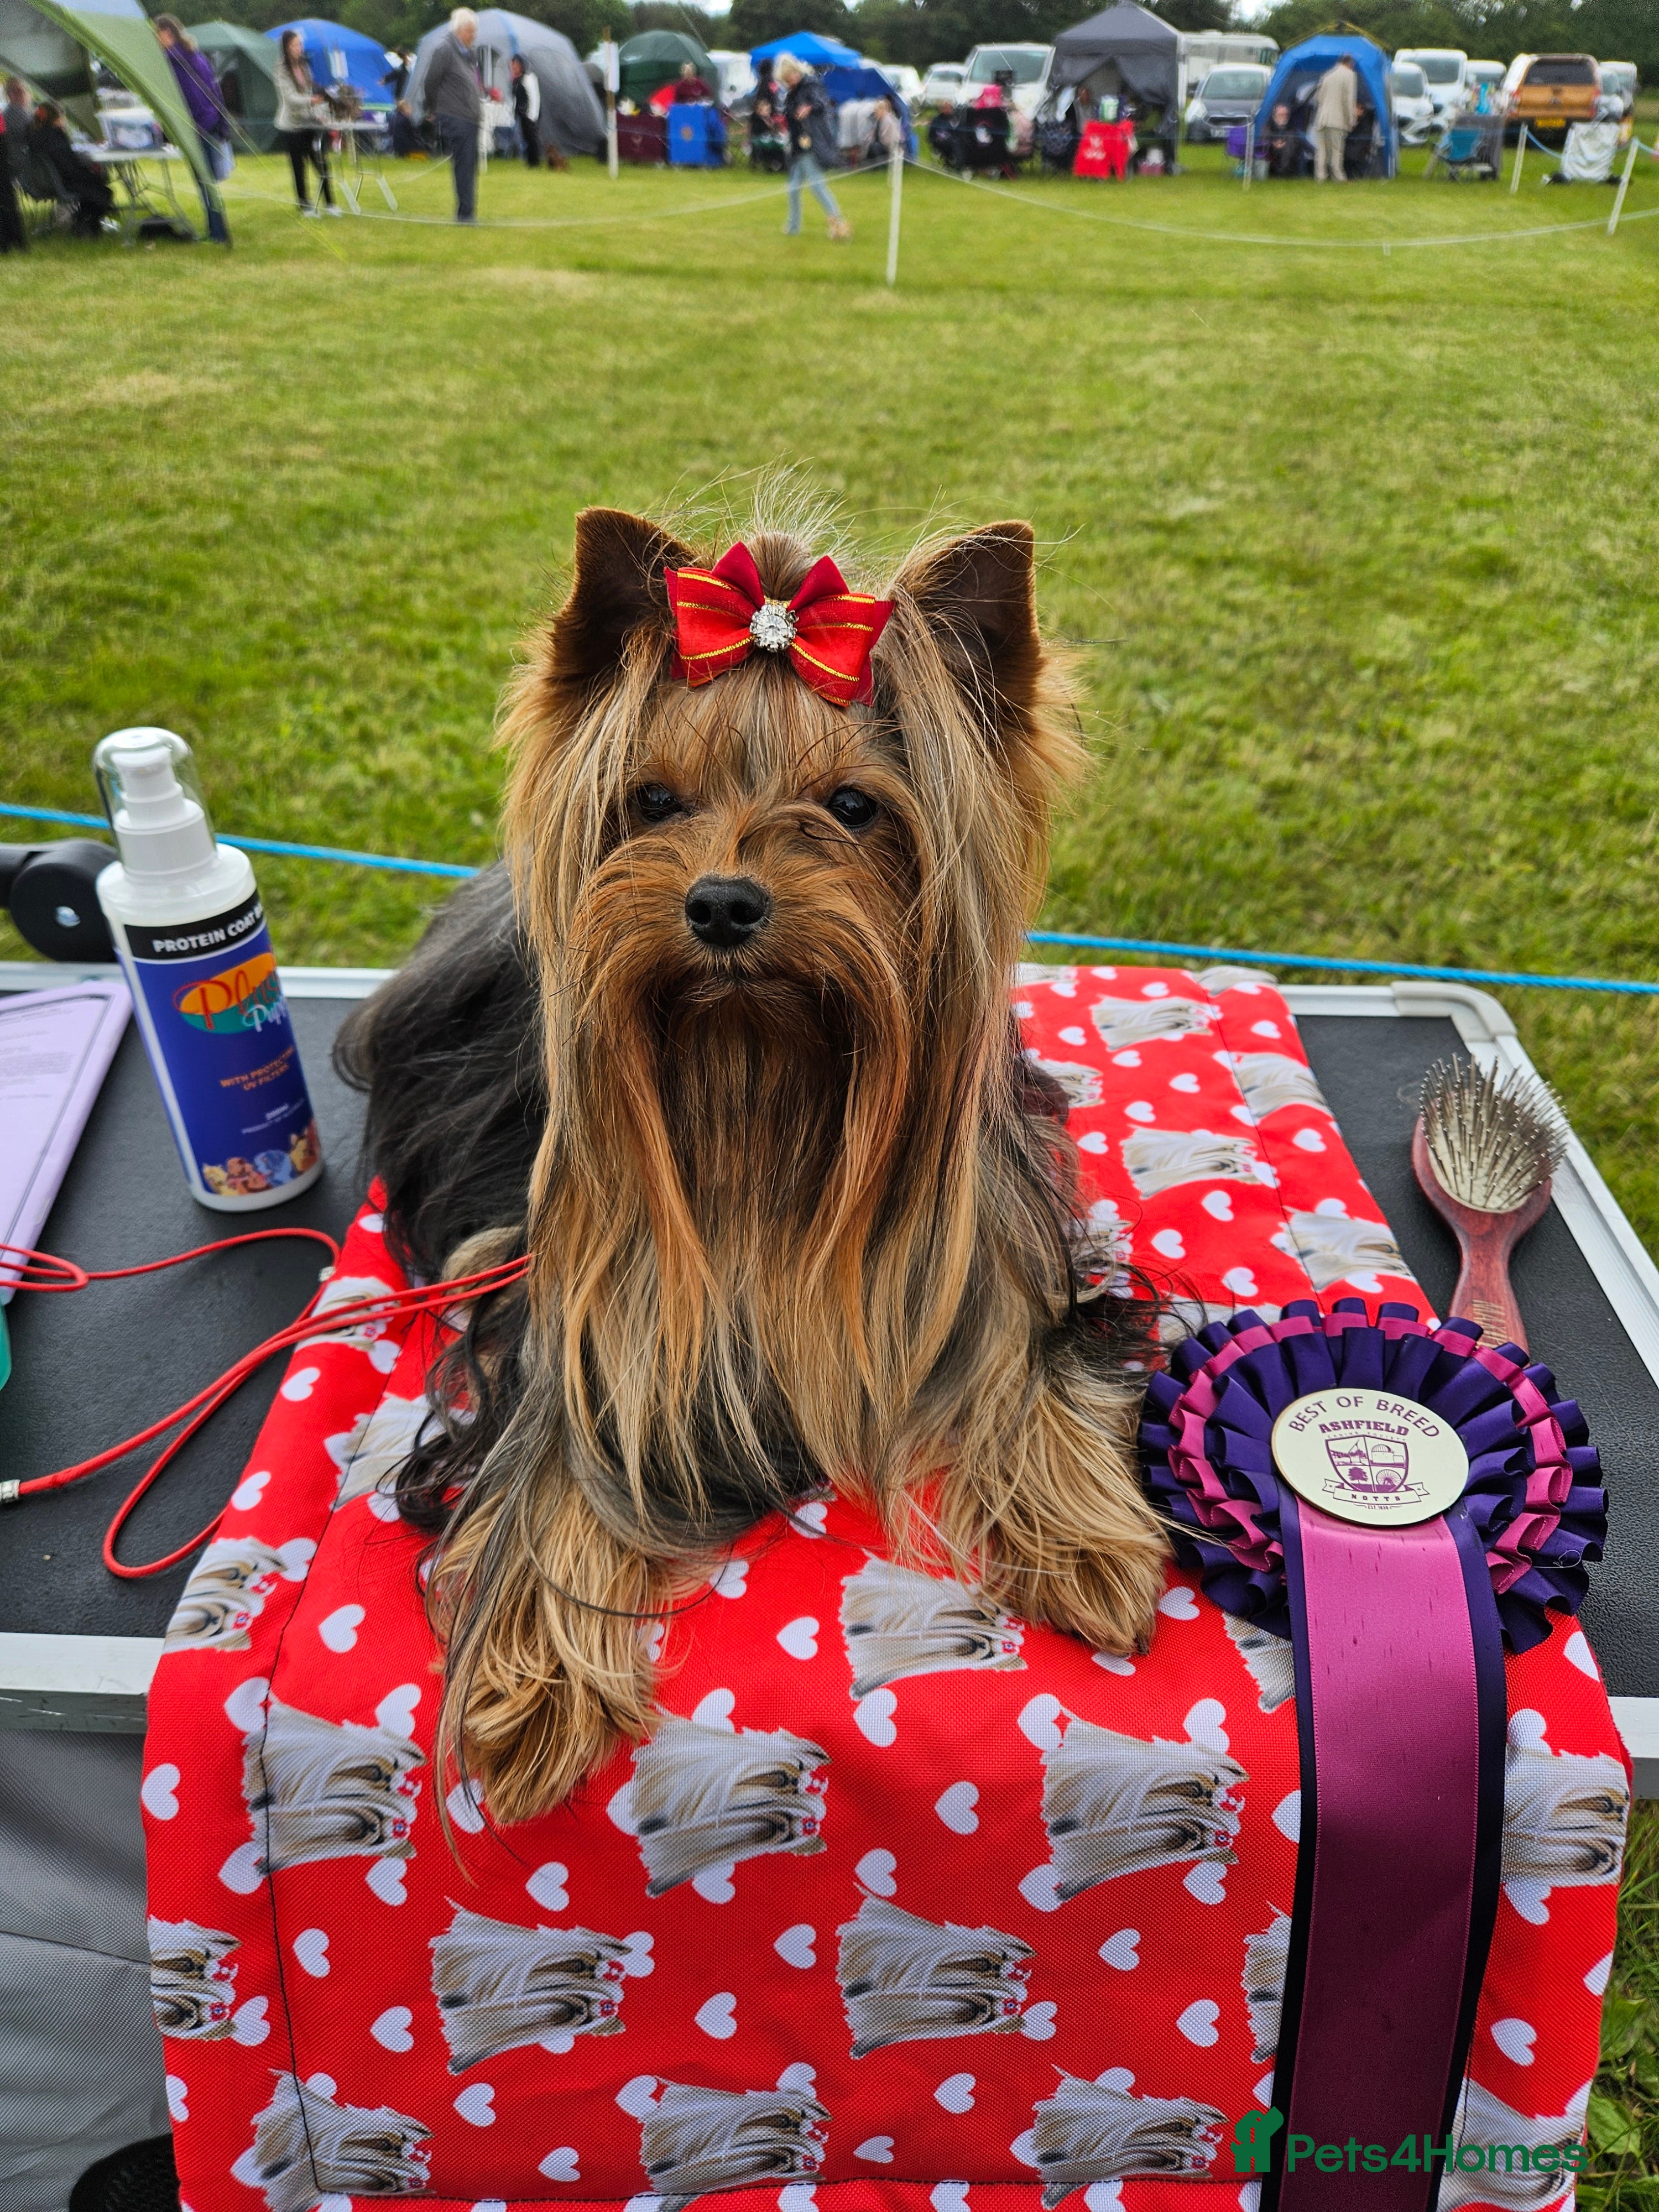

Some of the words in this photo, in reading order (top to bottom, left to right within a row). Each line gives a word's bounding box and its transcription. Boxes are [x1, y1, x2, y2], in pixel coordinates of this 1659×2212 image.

[152, 928, 226, 952] PROTEIN
[227, 910, 257, 937] COAT
[1288, 1401, 1327, 1432] BEST
[1336, 1396, 1364, 1408] OF
[1376, 1399, 1440, 1438] BREED
[1318, 1420, 1410, 1436] ASHFIELD
[1351, 1494, 1401, 1502] NOTTS
